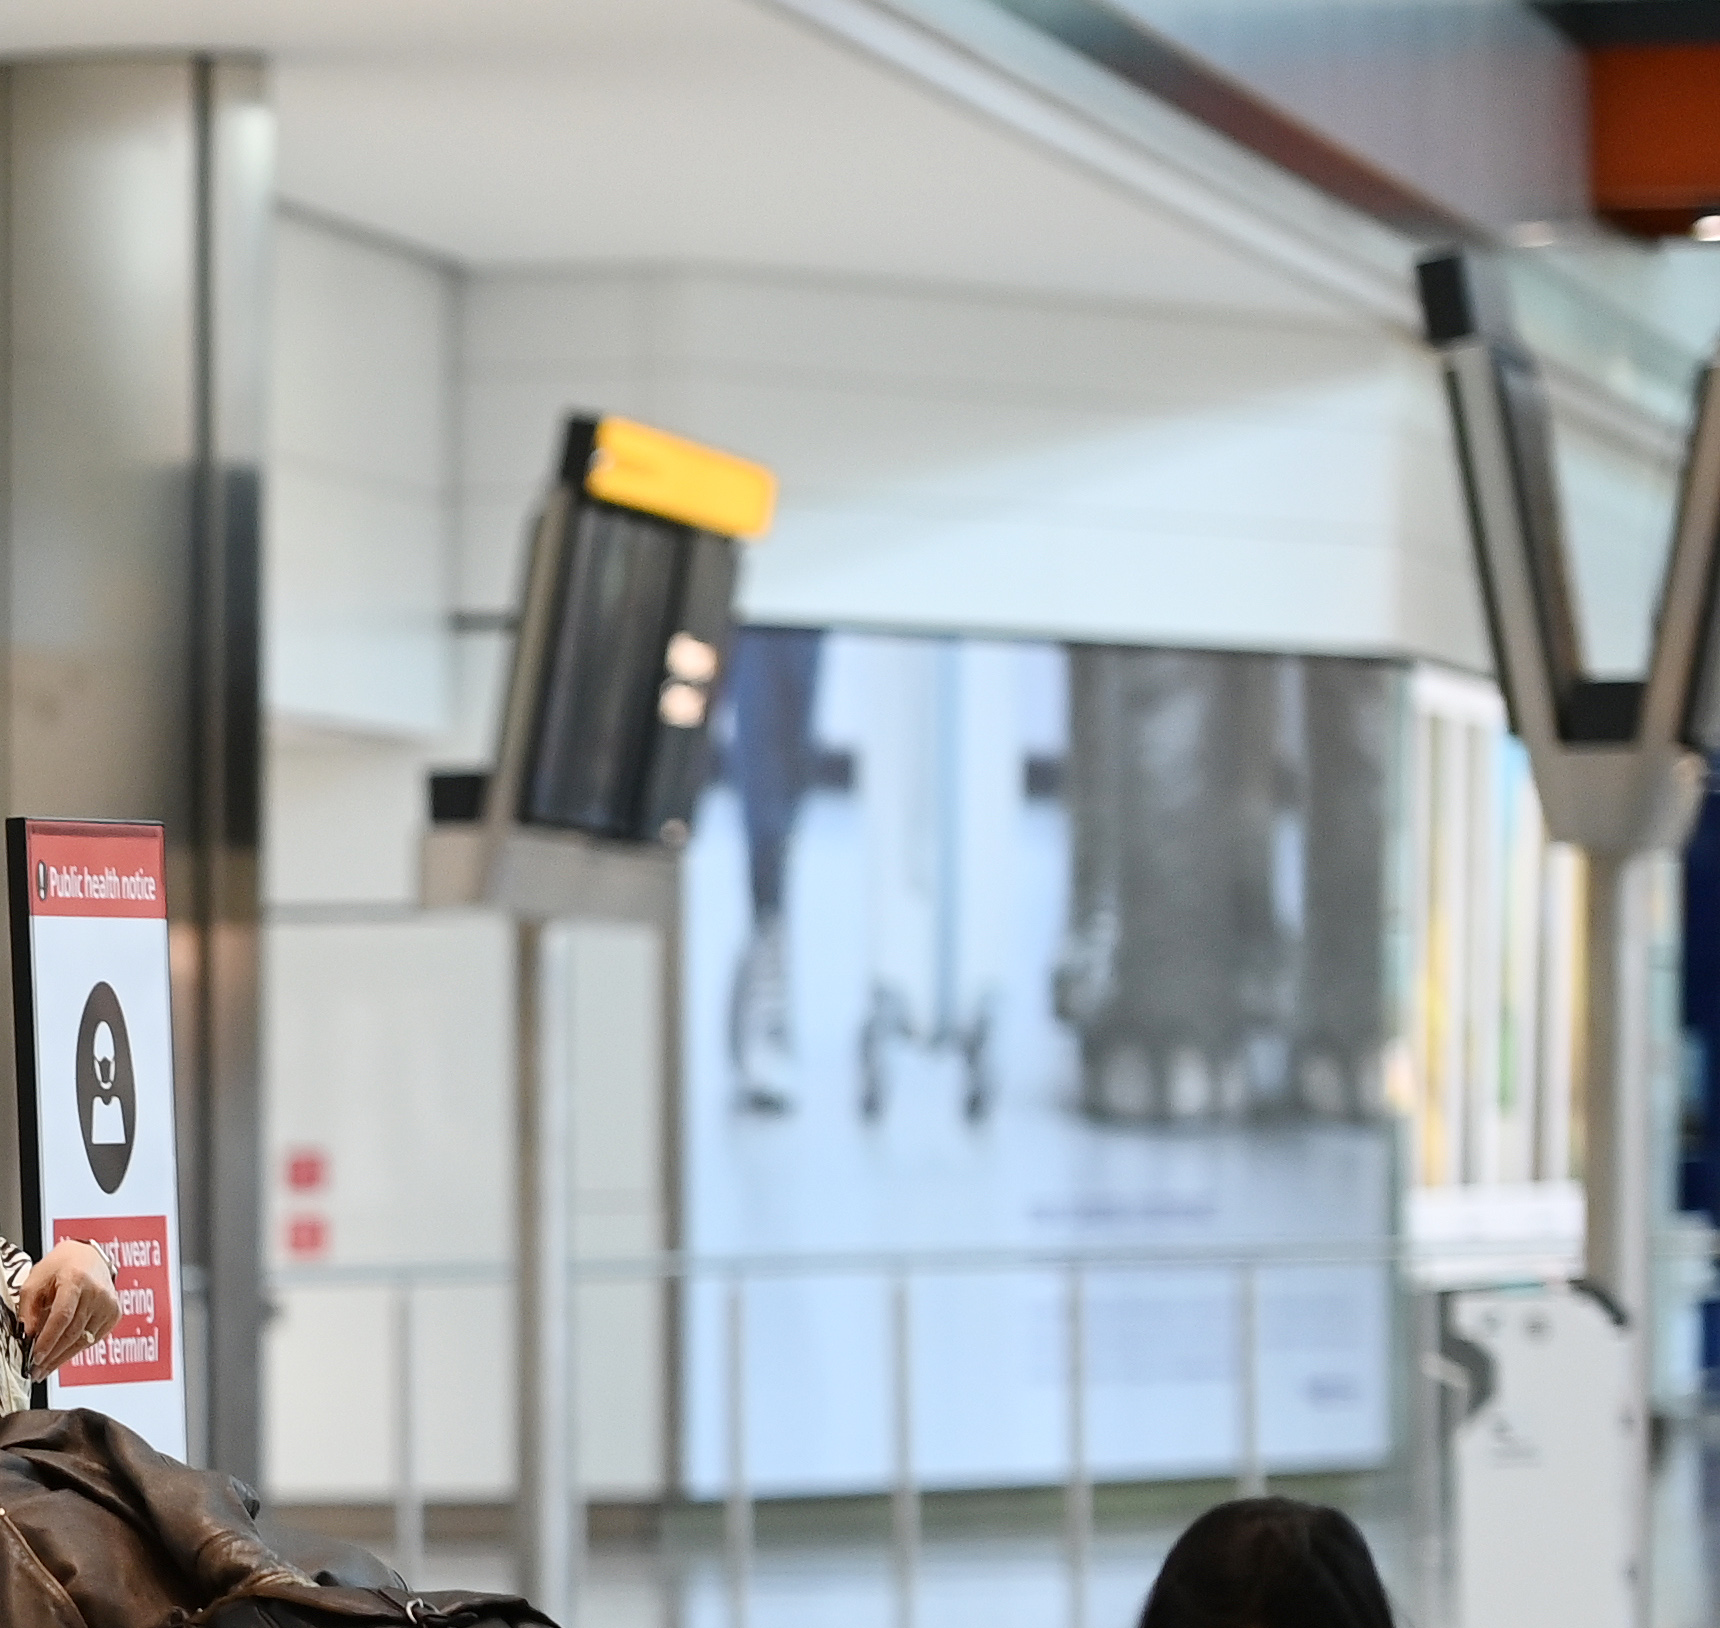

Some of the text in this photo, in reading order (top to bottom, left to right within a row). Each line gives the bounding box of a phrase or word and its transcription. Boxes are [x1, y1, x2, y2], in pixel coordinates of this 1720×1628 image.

[49, 866, 83, 898] Public
[84, 866, 121, 899] health
[122, 868, 156, 900] notice
[121, 1240, 151, 1267] wear
[152, 1239, 161, 1266] a
[117, 1279, 155, 1324] vering
[108, 1327, 159, 1366] terminal
